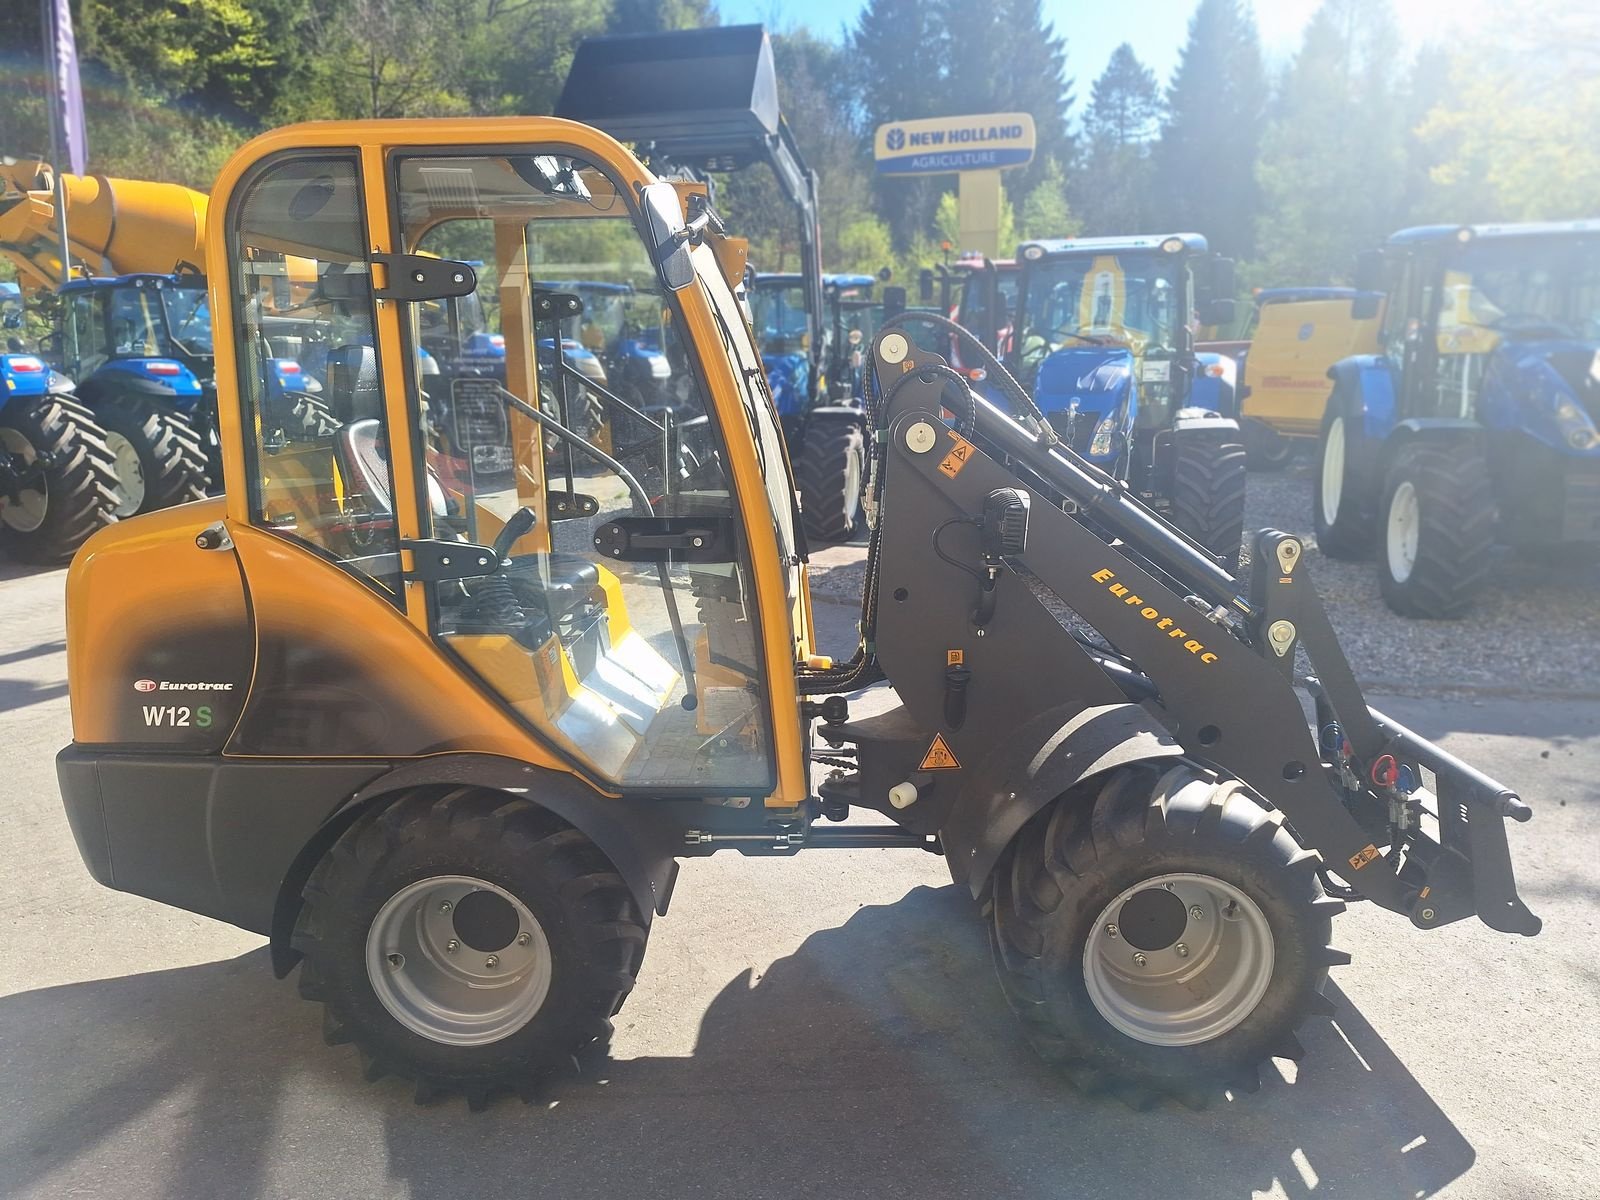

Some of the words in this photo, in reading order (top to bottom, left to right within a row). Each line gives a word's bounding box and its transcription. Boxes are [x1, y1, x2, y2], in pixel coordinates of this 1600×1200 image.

[909, 131, 945, 146] NEW
[948, 125, 1023, 144] HOLLAND
[911, 151, 996, 168] AGRICULTURE
[1091, 568, 1218, 664] Eurotrac
[159, 681, 233, 691] Eurotrac
[142, 706, 191, 727] W12
[196, 706, 212, 727] S
